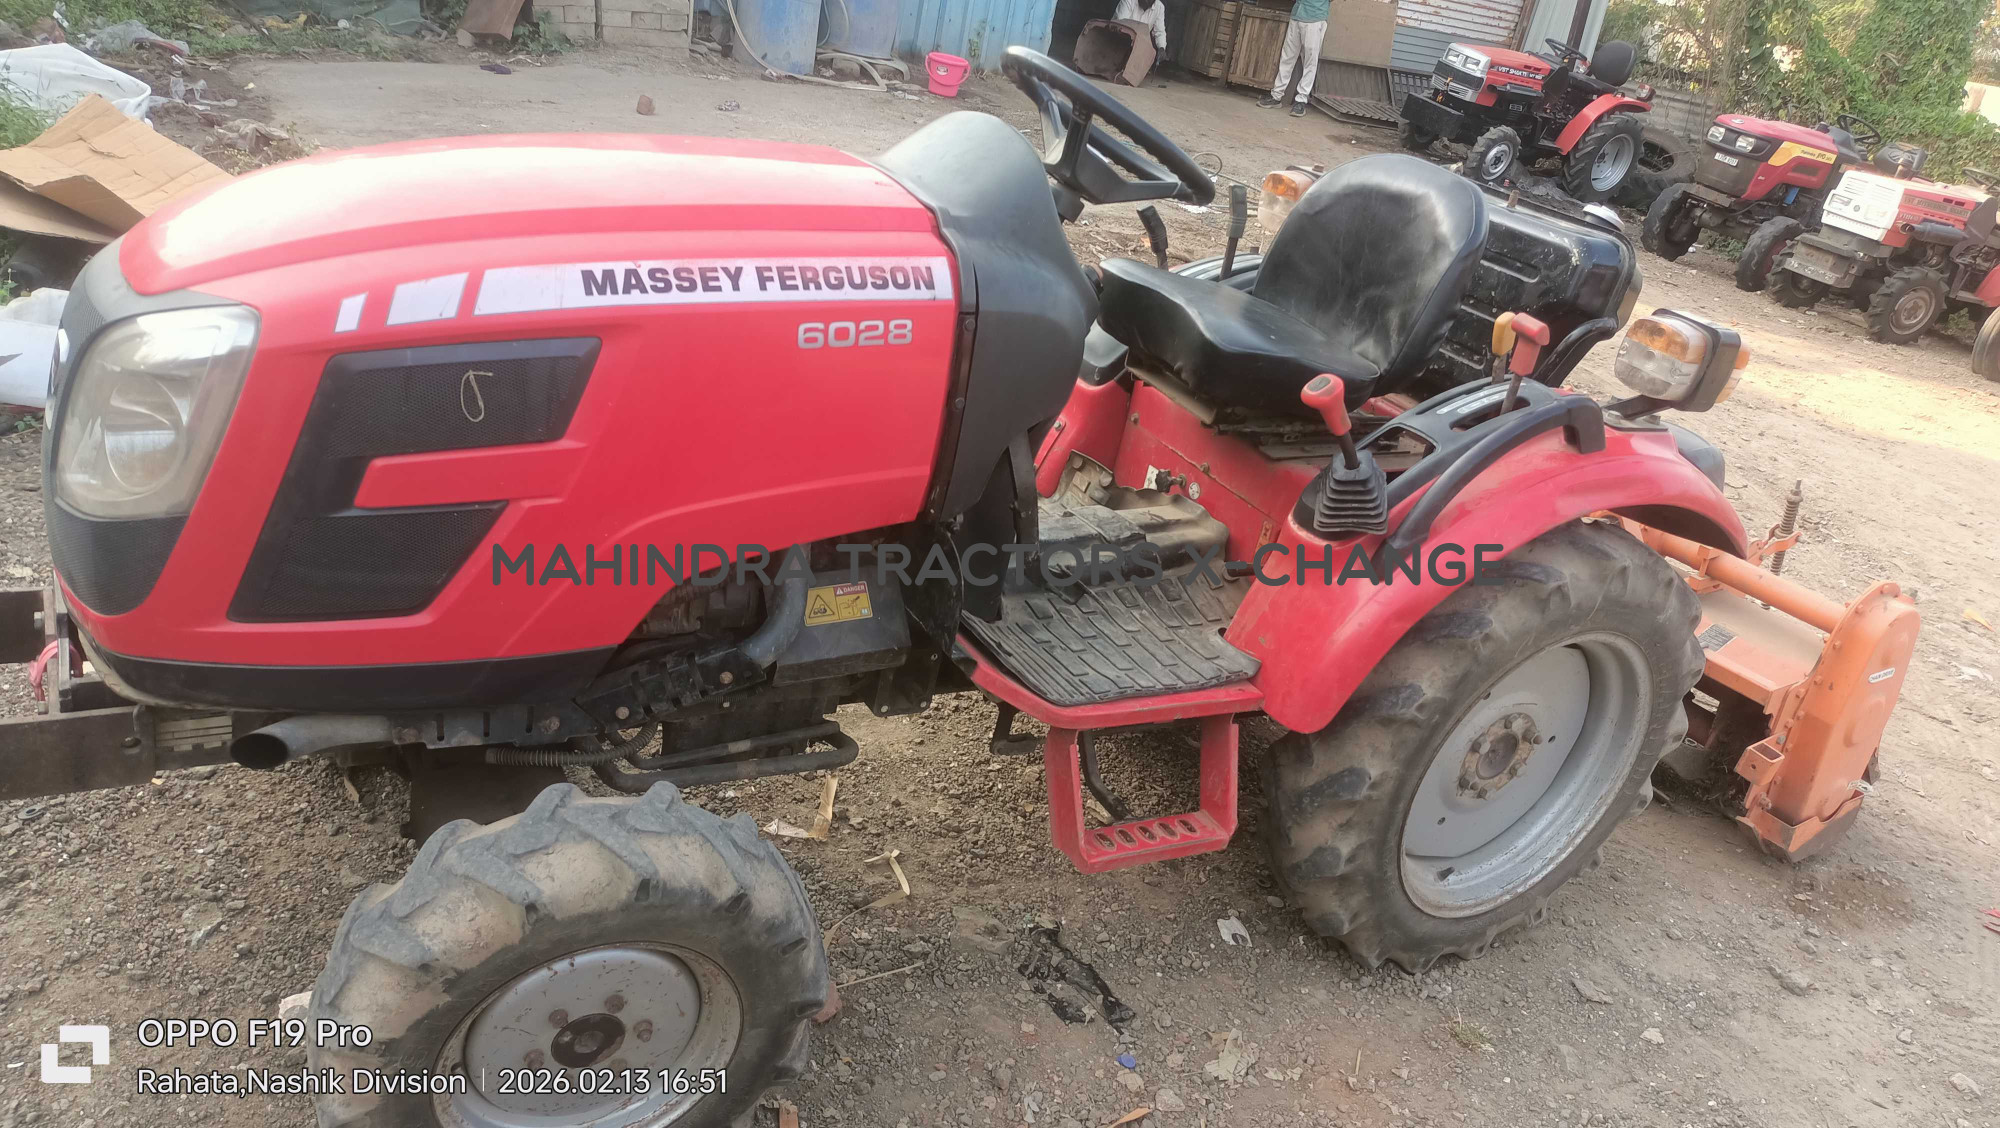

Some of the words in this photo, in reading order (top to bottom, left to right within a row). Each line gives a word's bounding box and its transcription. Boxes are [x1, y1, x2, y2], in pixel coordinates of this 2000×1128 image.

[582, 264, 745, 296] MASSEY
[756, 264, 936, 292] FERGUSON
[797, 318, 914, 350] 6028
[843, 584, 866, 594] DANGER
